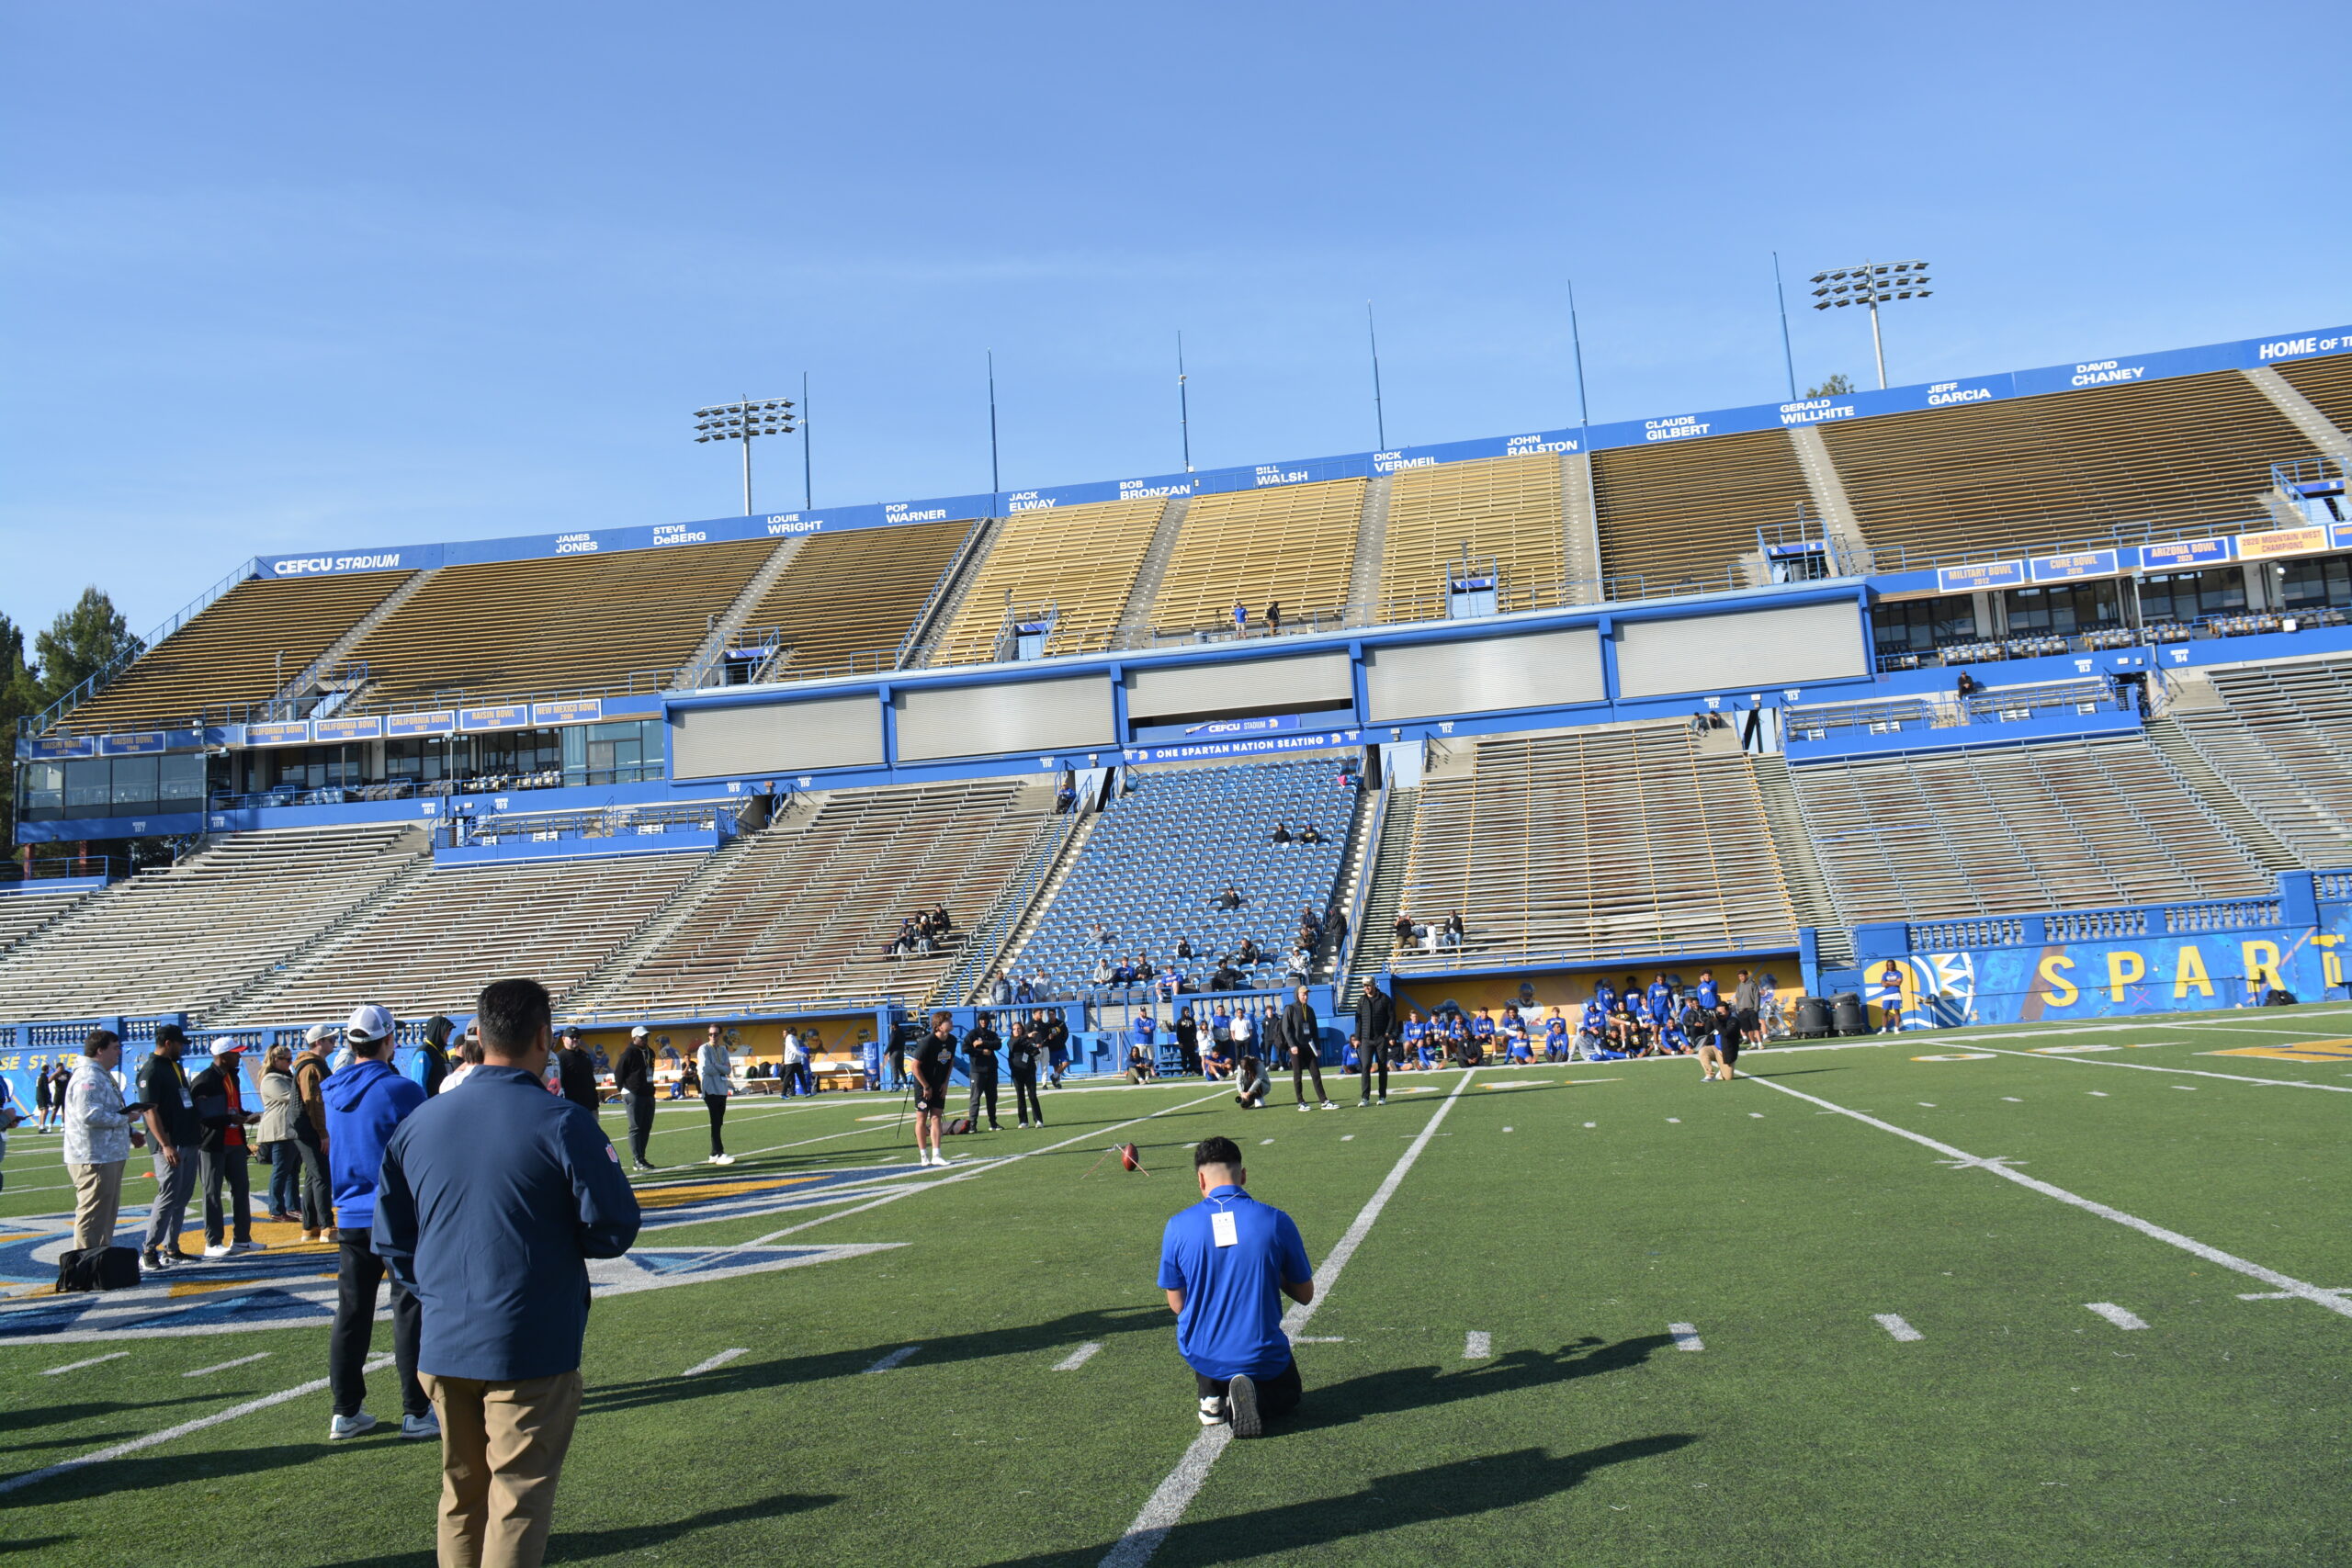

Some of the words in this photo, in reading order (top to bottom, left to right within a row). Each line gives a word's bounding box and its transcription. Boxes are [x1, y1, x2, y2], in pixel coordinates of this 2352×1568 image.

[2260, 337, 2317, 359] HOME
[2320, 339, 2339, 351] OF
[2076, 361, 2118, 374] DAVID
[2072, 367, 2144, 387] CHANEY
[1928, 383, 1958, 394] JEFF
[1928, 389, 1992, 405] GARCIA
[1781, 400, 1831, 412] GERALD
[1781, 406, 1855, 424] WILLHITE
[1645, 416, 1696, 430] CLAUDE
[1646, 423, 1711, 441] GILBERT
[1507, 435, 1542, 446] JOHN
[1507, 440, 1578, 456] RALSTON
[1374, 451, 1402, 461] DICK
[1256, 466, 1280, 475] BILL
[1374, 457, 1439, 473] VERMEIL
[1257, 471, 1308, 486] WALSH
[1120, 480, 1144, 490] BOB
[1009, 491, 1038, 502] JACK
[1120, 484, 1191, 501] BRONZAN
[886, 504, 909, 513] POP
[1009, 499, 1057, 513] ELWAY
[767, 514, 799, 525] LOUIE
[887, 510, 946, 524] WARNER
[653, 525, 686, 535] STEVE
[767, 520, 823, 534] WRIGHT
[556, 534, 590, 543] JAMES
[653, 532, 707, 545] DeBERG
[2261, 533, 2299, 544] MOUNTAIN
[2301, 530, 2321, 540] WEST
[556, 541, 598, 554] JONES
[2152, 545, 2189, 558] ARIZONA
[2191, 542, 2217, 553] BOWL
[2262, 541, 2304, 552] CHAMPIONS
[274, 558, 334, 574] CEFCU
[335, 554, 400, 570] STADIUM
[2050, 558, 2072, 570] CURE
[2074, 556, 2098, 567] BOWL
[1949, 567, 1987, 580] MILITARY
[1988, 565, 2013, 576] BOWL
[1973, 577, 1990, 585] 2012
[1787, 693, 1799, 702] 113
[537, 706, 552, 715] NEW
[553, 705, 577, 714] MEXICO
[579, 703, 597, 712] BOWL
[1708, 700, 1720, 709] 112
[472, 710, 494, 720] RAISIN
[496, 708, 514, 718] BOWL
[319, 722, 356, 731] CALIFORNIA
[358, 720, 377, 729] BOWL
[391, 716, 430, 727] CALIFORNIA
[432, 714, 450, 723] BOWL
[248, 727, 284, 736] CALIFORNIA
[287, 725, 304, 734] BOWL
[1208, 723, 1240, 733] CEFCU
[1244, 721, 1266, 730] STADIUM
[1442, 725, 1453, 734] 112
[42, 741, 62, 750] RAISIN
[64, 739, 82, 749] BOWL
[112, 737, 133, 745] RAISIN
[136, 735, 154, 744] BOWL
[1157, 749, 1178, 759] ONE
[1182, 745, 1229, 756] SPARTAN
[1233, 741, 1274, 752] NATION
[1277, 736, 1324, 749] SEATING
[1043, 760, 1052, 769] 110
[800, 779, 810, 788] 110
[28, 1053, 79, 1070] STTE
